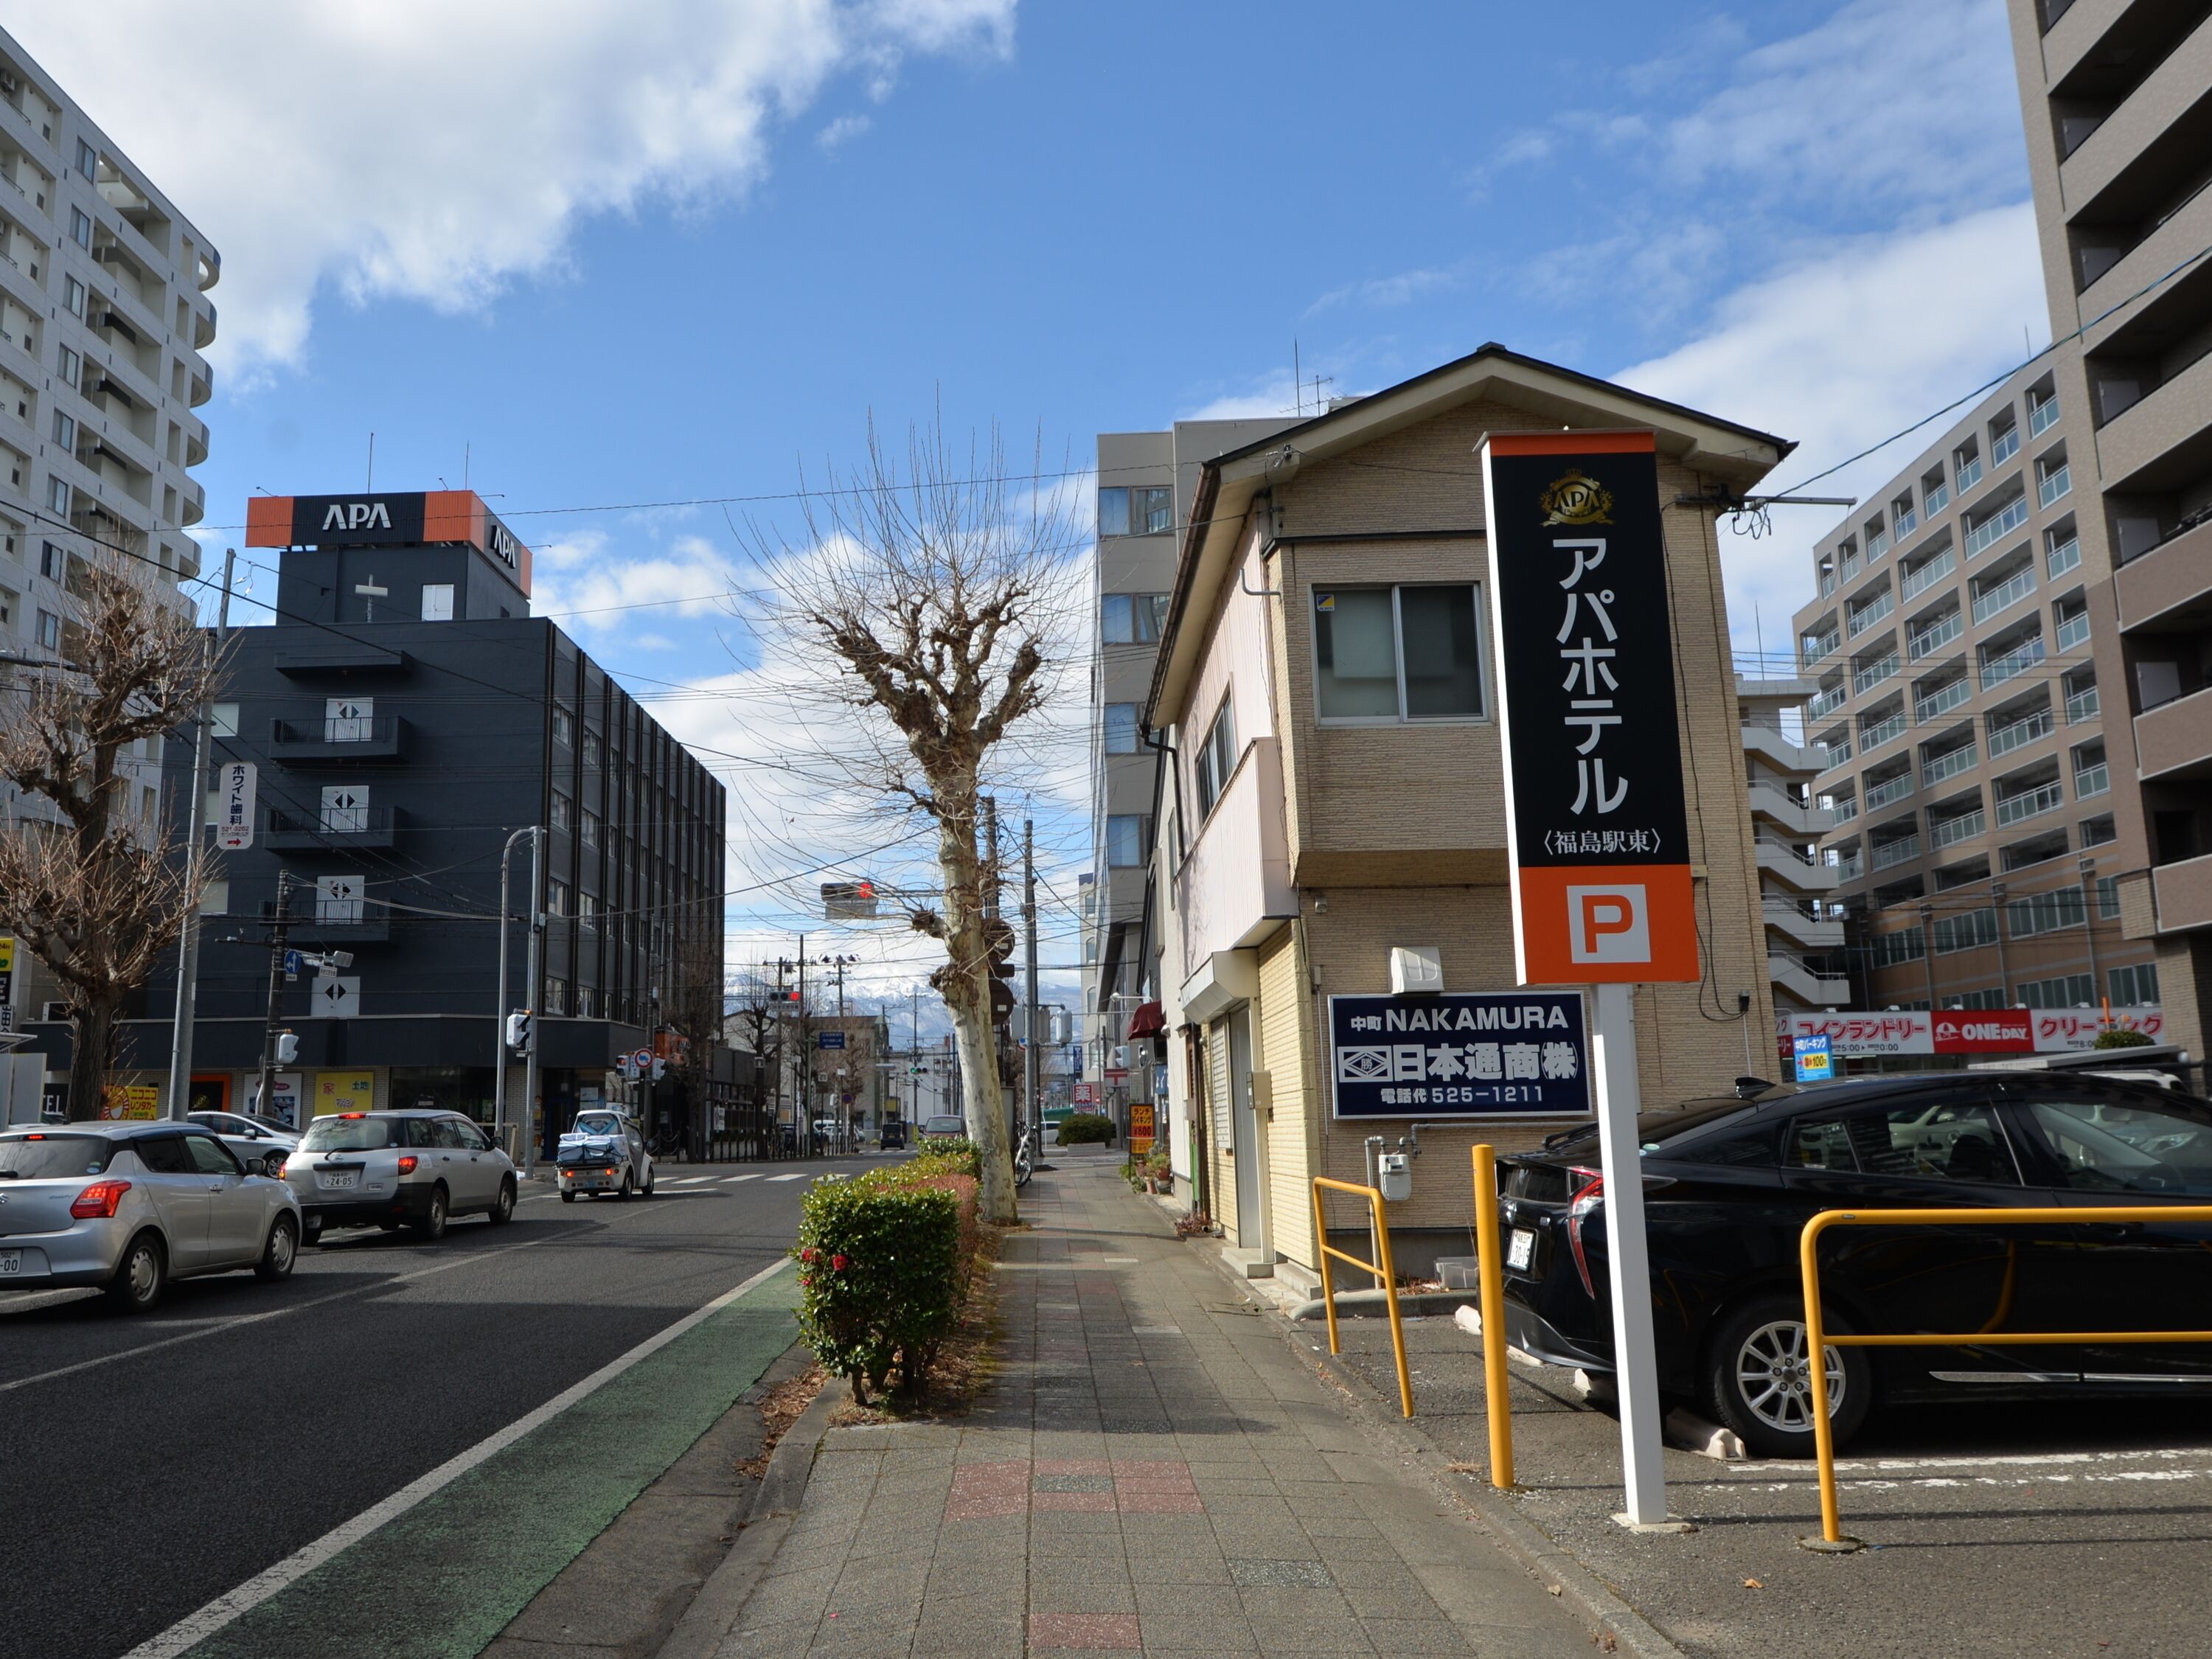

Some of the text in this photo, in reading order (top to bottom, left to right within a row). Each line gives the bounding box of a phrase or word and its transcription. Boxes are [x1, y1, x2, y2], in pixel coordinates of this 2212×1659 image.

[1554, 490, 1600, 508] APA
[322, 503, 392, 531] APA
[491, 525, 516, 568] APA
[1552, 538, 1628, 815] アパホテル
[229, 765, 245, 825] ホワイト歯科
[1582, 894, 1634, 953] P
[1351, 1006, 1569, 1032] 中町 NAKAMURA
[131, 1088, 156, 1100] ニコニコ
[352, 1081, 369, 1091] 土地
[1076, 1085, 1091, 1102] 薬
[130, 1102, 156, 1111] レンタカー
[1133, 1107, 1150, 1116] ランチ
[330, 1177, 352, 1186] 24-05
